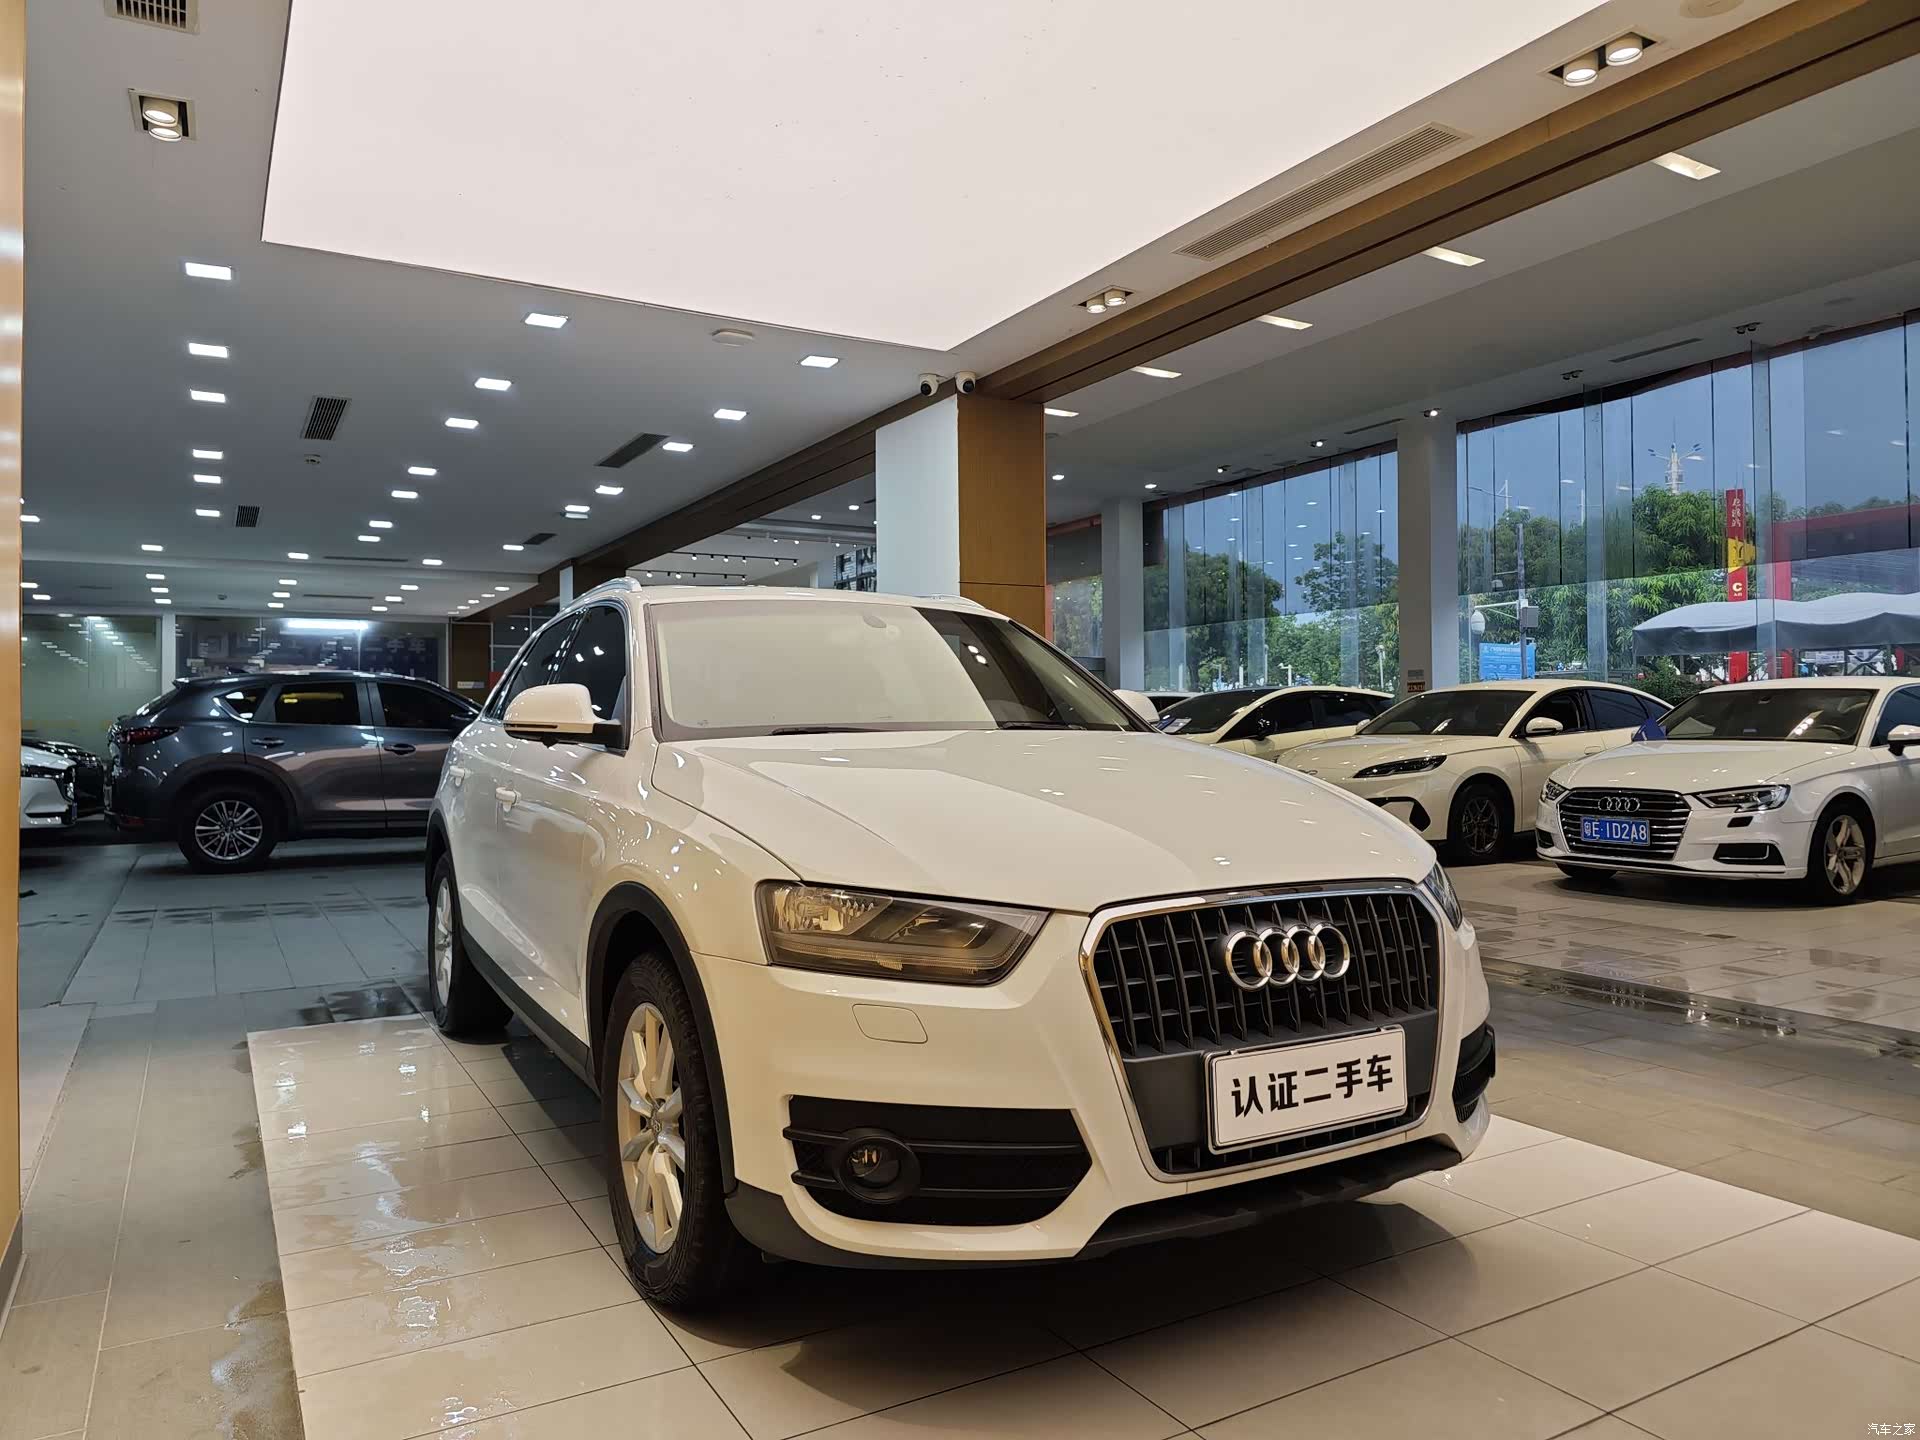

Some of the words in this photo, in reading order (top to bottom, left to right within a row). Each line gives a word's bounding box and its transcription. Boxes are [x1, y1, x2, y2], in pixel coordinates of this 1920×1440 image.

[1231, 1054, 1393, 1118] 认证二手车
